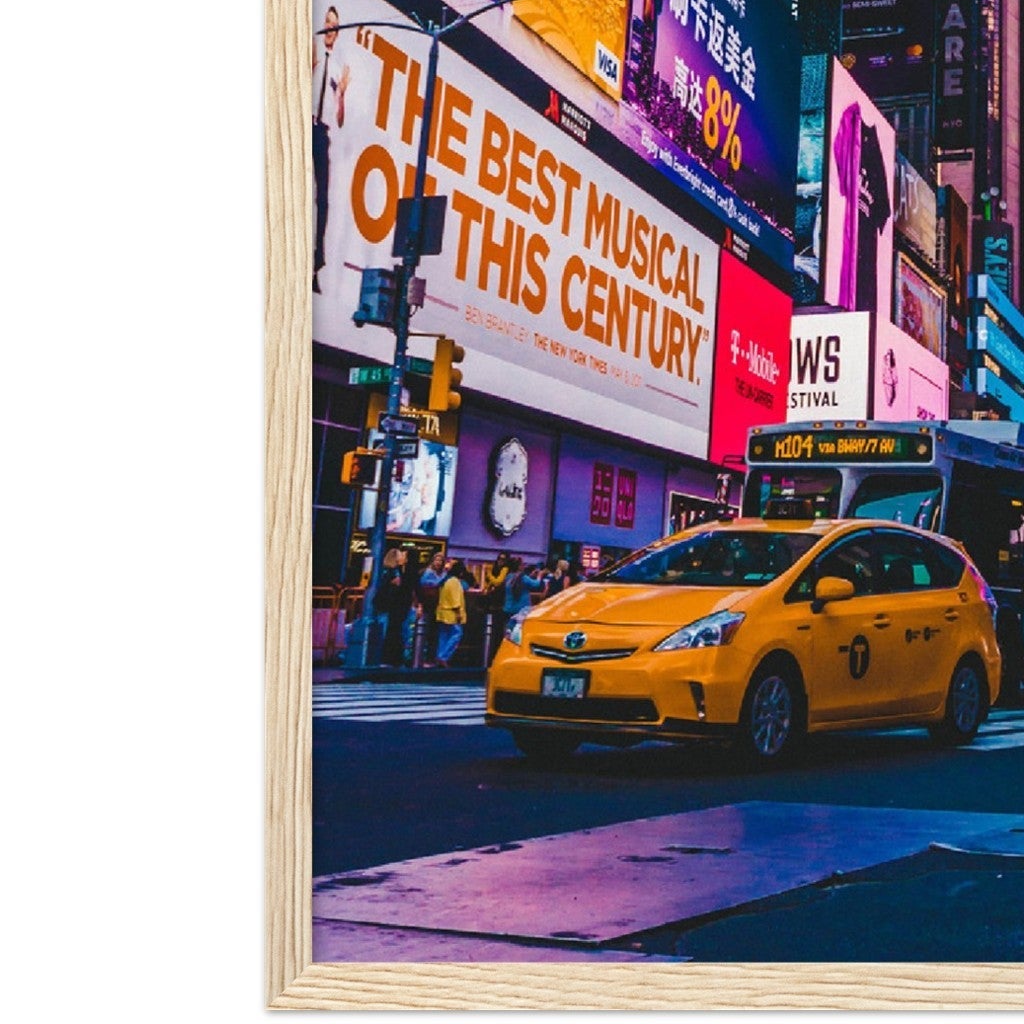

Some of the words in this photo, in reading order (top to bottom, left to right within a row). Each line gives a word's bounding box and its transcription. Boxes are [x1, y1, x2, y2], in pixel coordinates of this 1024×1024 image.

[598, 48, 617, 82] VISA
[478, 107, 582, 236] BEST
[583, 180, 706, 315] MUSICAL
[451, 189, 550, 315] THIS
[465, 304, 484, 324] BEN
[534, 332, 549, 351] THE
[550, 338, 567, 358] NEW
[568, 346, 586, 366] YORK
[589, 355, 608, 375] TIMES
[789, 335, 841, 385] WS
[775, 435, 814, 459] M104
[879, 438, 896, 454] AV
